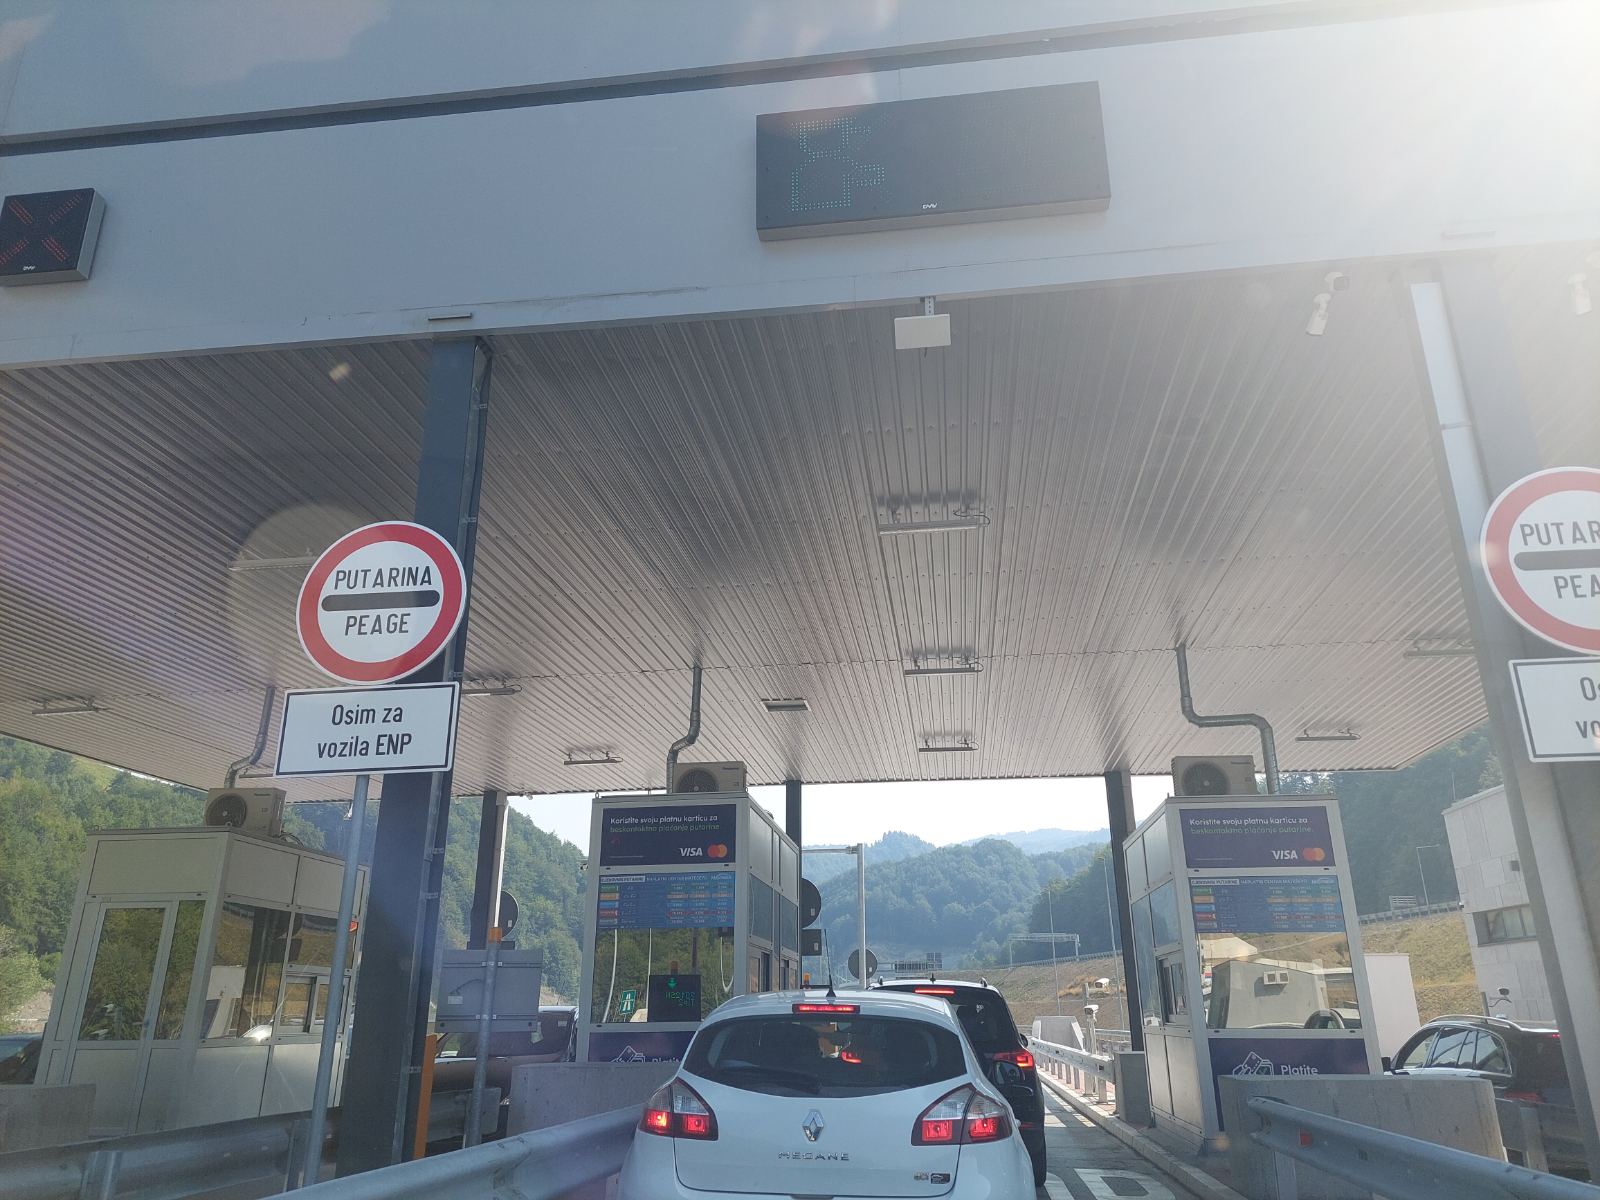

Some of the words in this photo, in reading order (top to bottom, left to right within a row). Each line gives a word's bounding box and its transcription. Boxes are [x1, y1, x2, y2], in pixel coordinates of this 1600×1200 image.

[334, 566, 433, 590] PUTARINA
[344, 613, 411, 636] PEAGE
[331, 704, 376, 726] Osim
[382, 706, 403, 724] za
[317, 735, 370, 759] vozila
[375, 733, 412, 756] ENP
[610, 816, 639, 824] Koristite
[640, 817, 658, 825] svoju
[659, 815, 682, 824] platnu
[683, 814, 708, 822] karticu
[1189, 818, 1221, 826] Koristite
[1222, 818, 1242, 826] svoju
[1243, 817, 1268, 826] platnu
[1269, 817, 1296, 825] karticu
[679, 848, 703, 857] VISA
[1272, 850, 1298, 860] VISA
[1280, 1064, 1318, 1075] Platite
[777, 1151, 850, 1161] MEGANE
